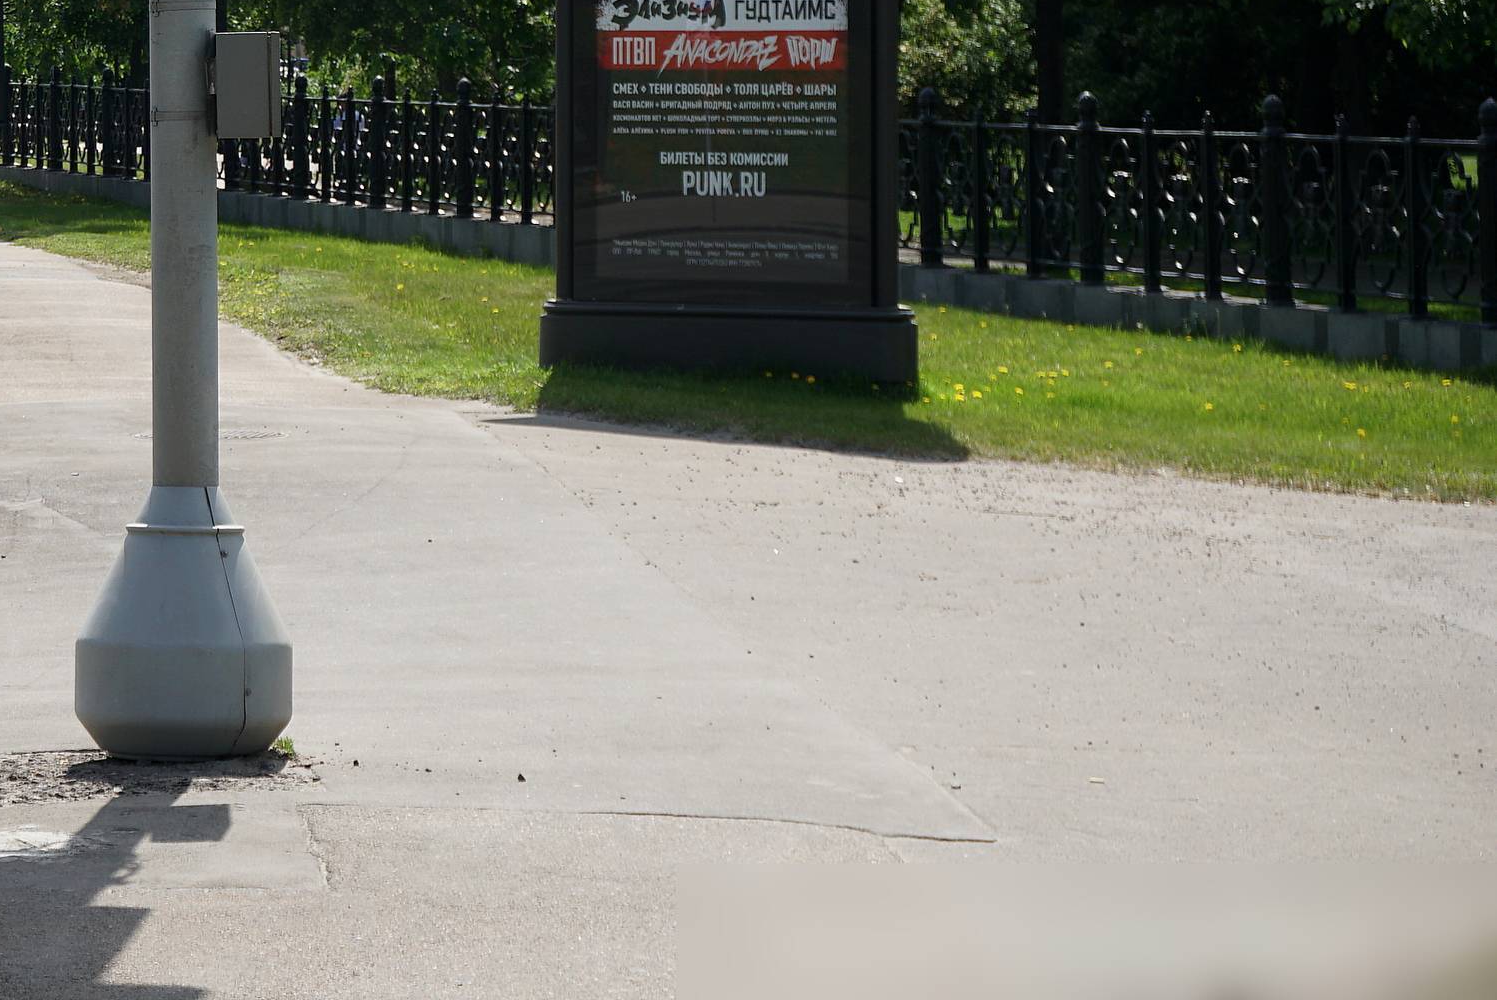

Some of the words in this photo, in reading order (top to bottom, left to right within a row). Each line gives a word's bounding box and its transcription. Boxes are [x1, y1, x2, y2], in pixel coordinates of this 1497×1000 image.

[612, 36, 656, 65] ПТВП
[612, 83, 639, 95] СМЕХ
[648, 83, 673, 95] ТЕНИ
[675, 83, 723, 97] СВОБОДЫ
[733, 83, 759, 96] ТОЛЯ
[761, 81, 794, 98] ЦАРЁВ
[804, 83, 837, 96] ШАРЫ
[612, 100, 631, 109] ВАСЯ
[660, 100, 703, 110] БРИГАДНЫЙ
[703, 100, 732, 111] ПОДРЯД
[739, 101, 761, 110] АНТОН
[762, 101, 776, 110] ПУХ
[782, 101, 809, 110] ЧЕТЫРЕ
[810, 101, 837, 111] АПРЕЛЯ
[660, 151, 704, 165] БИЛЕТЫ
[707, 152, 727, 165] БЕЗ
[730, 152, 789, 167] КОМИССИИ
[682, 170, 767, 197] PUNK.RU
[621, 191, 637, 203] 16+
